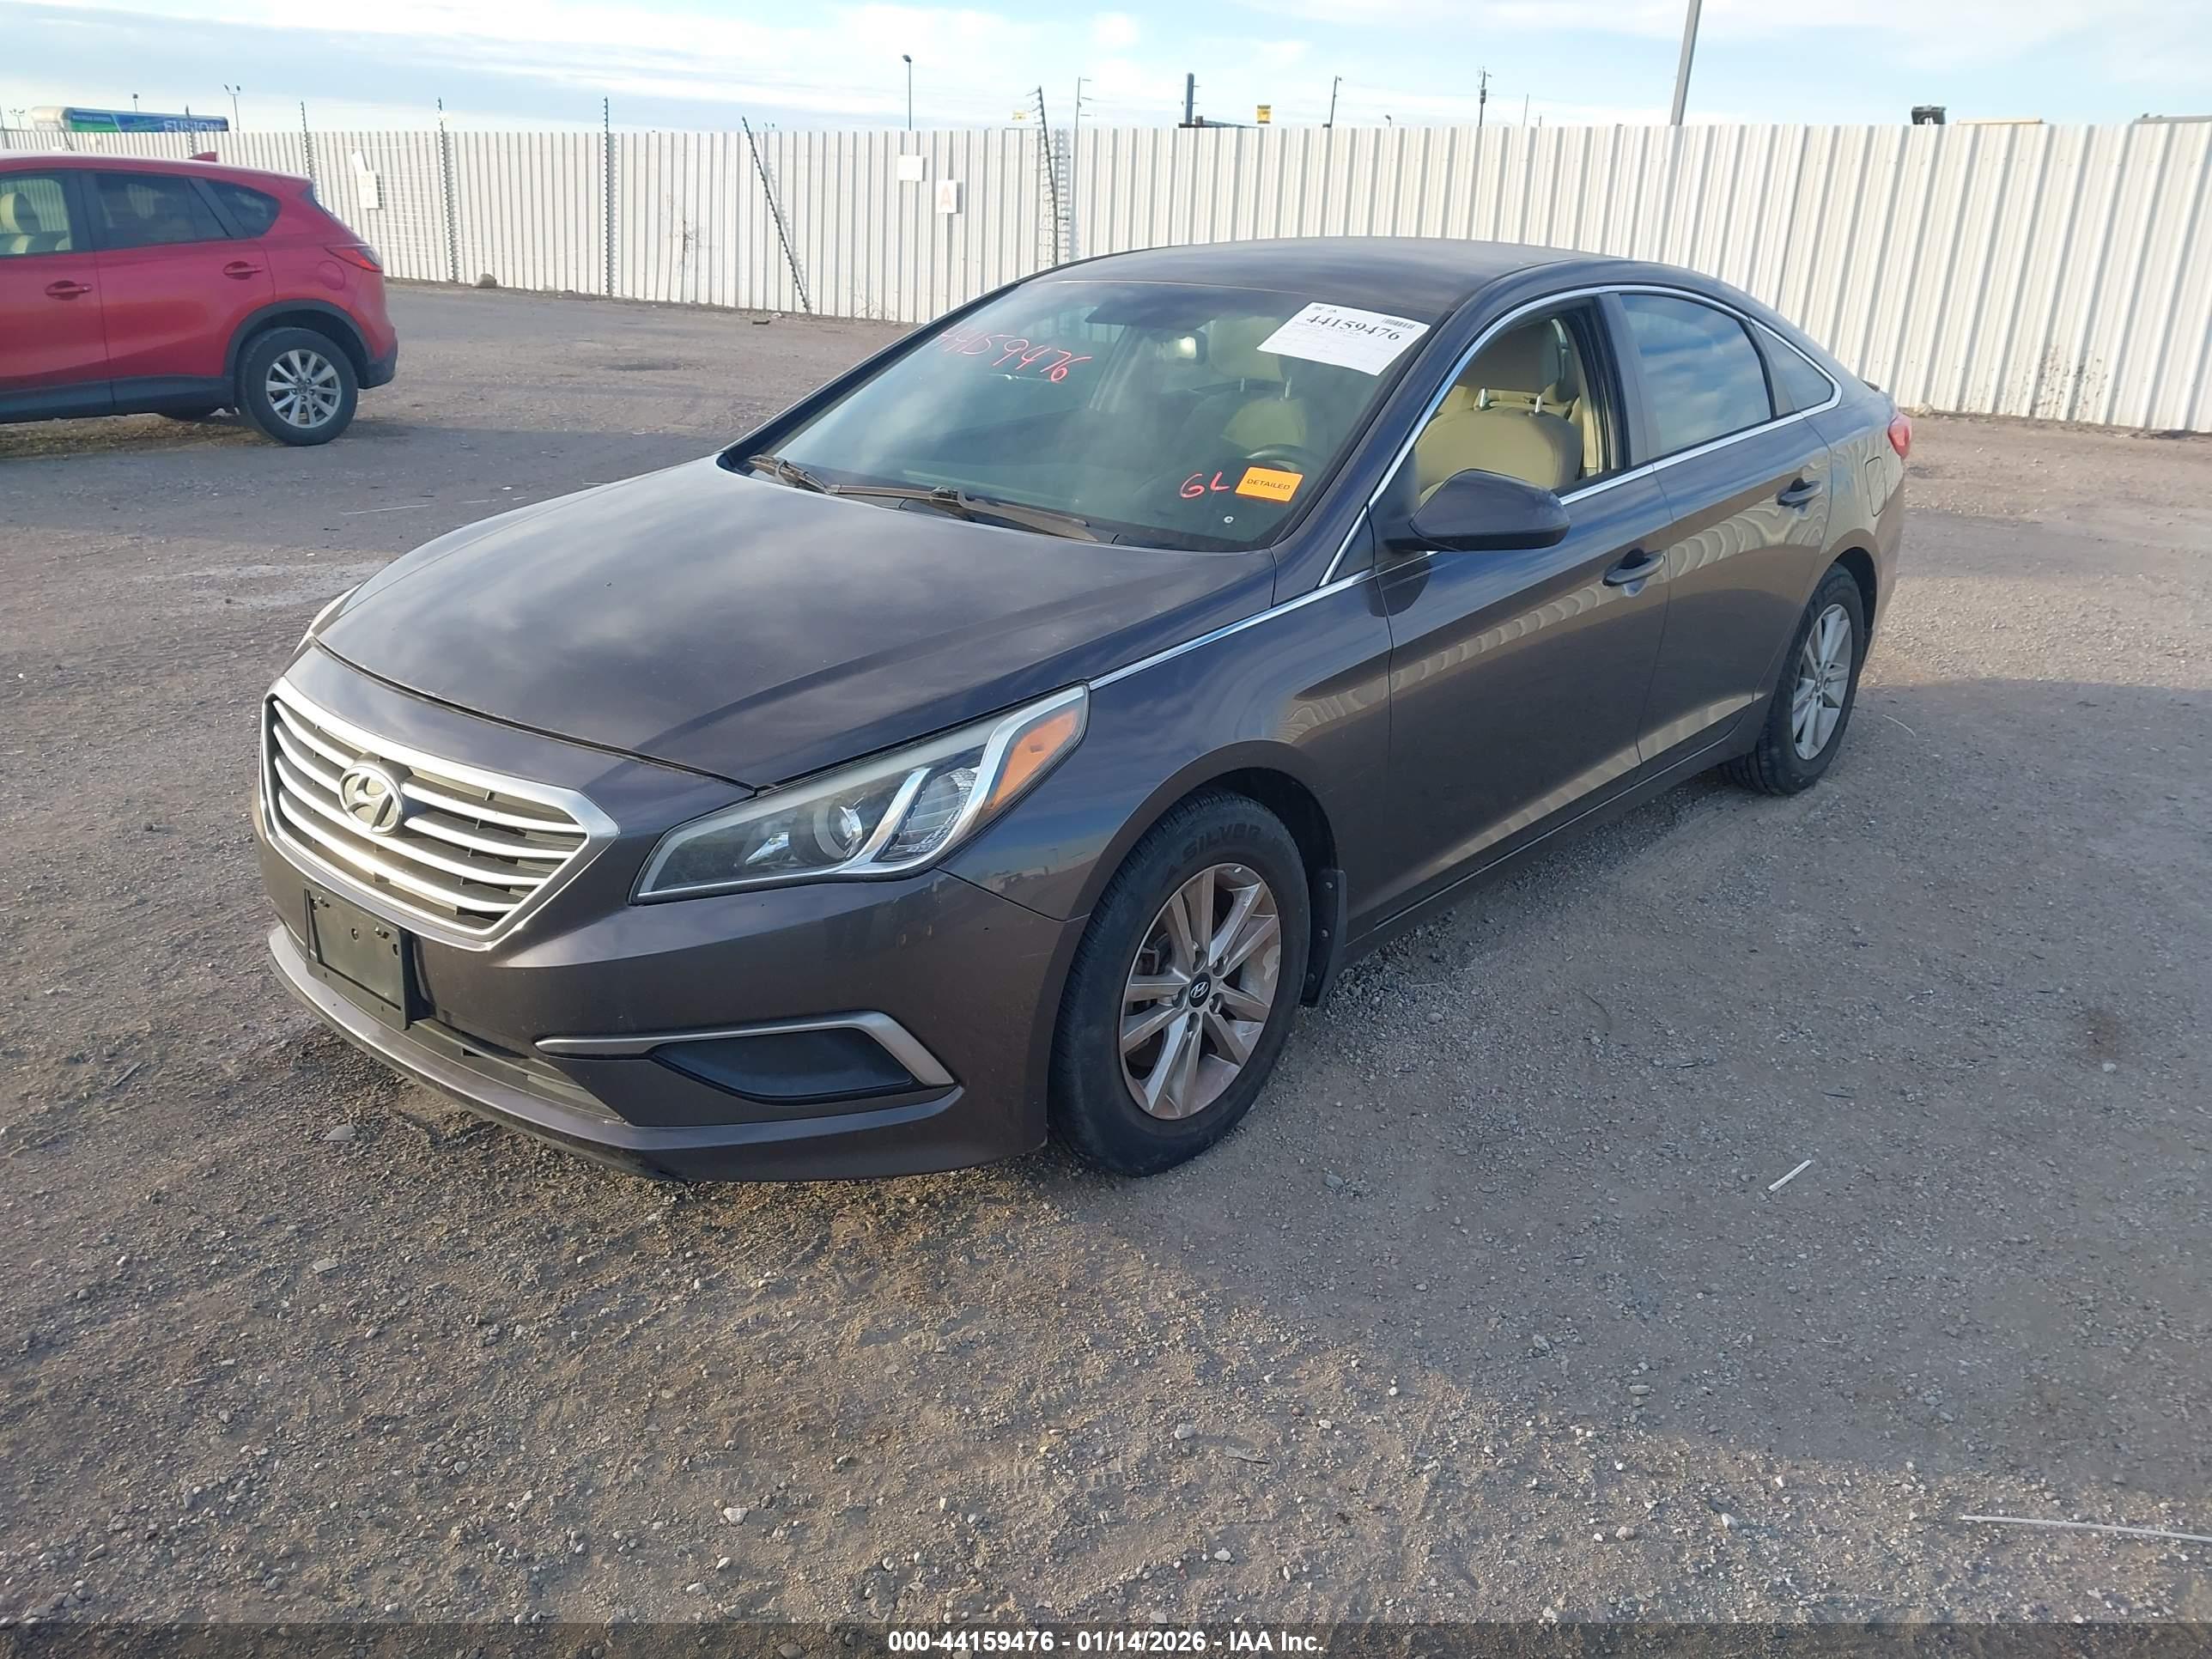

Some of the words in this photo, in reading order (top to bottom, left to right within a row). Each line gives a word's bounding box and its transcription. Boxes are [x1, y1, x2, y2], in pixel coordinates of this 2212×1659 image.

[163, 119, 221, 132] FUSION
[939, 184, 952, 209] A
[1306, 314, 1401, 341] 44159476
[1246, 477, 1291, 491] DETAILED
[1182, 822, 1261, 865] SILVER
